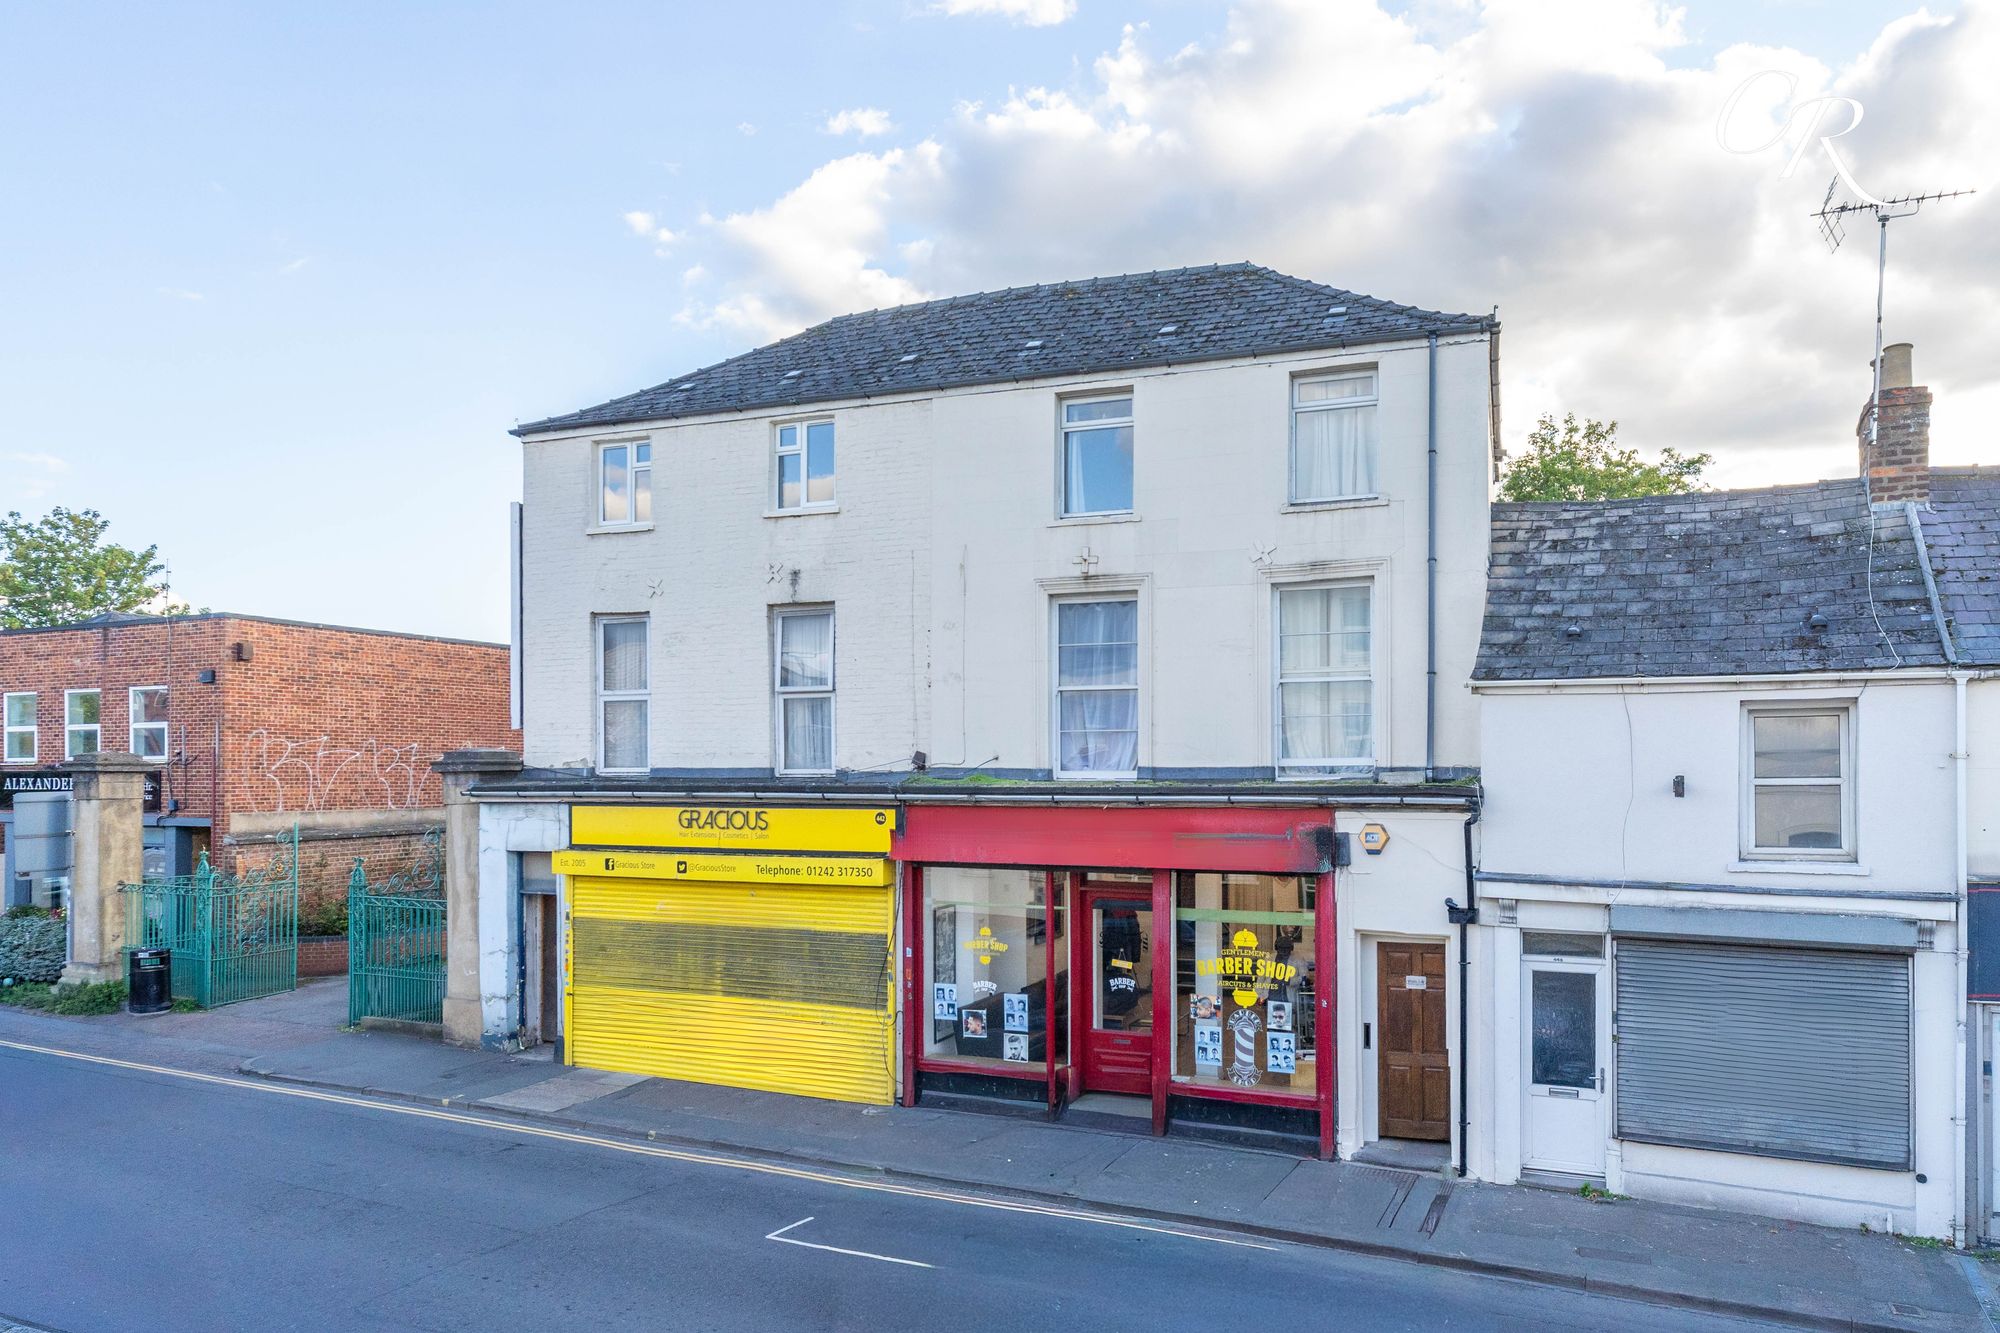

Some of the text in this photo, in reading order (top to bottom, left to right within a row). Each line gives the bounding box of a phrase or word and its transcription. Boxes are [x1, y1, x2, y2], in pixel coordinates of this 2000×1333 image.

[678, 810, 768, 831] GRACIOUS
[690, 831, 718, 839] Extensions
[722, 831, 749, 839] Cosmetics
[754, 832, 769, 840] Salon
[559, 859, 586, 867] Est. 2005
[615, 860, 639, 869] Gracious
[640, 861, 656, 870] Store
[688, 862, 737, 873] @GraciousStore
[756, 864, 873, 877] Telephone: 01242 317350
[1220, 948, 1271, 959] GENTLEMEN'S
[1197, 957, 1296, 982] BARBER SHOP
[1109, 977, 1136, 988] BARBER
[1252, 982, 1279, 990] SHAVES
